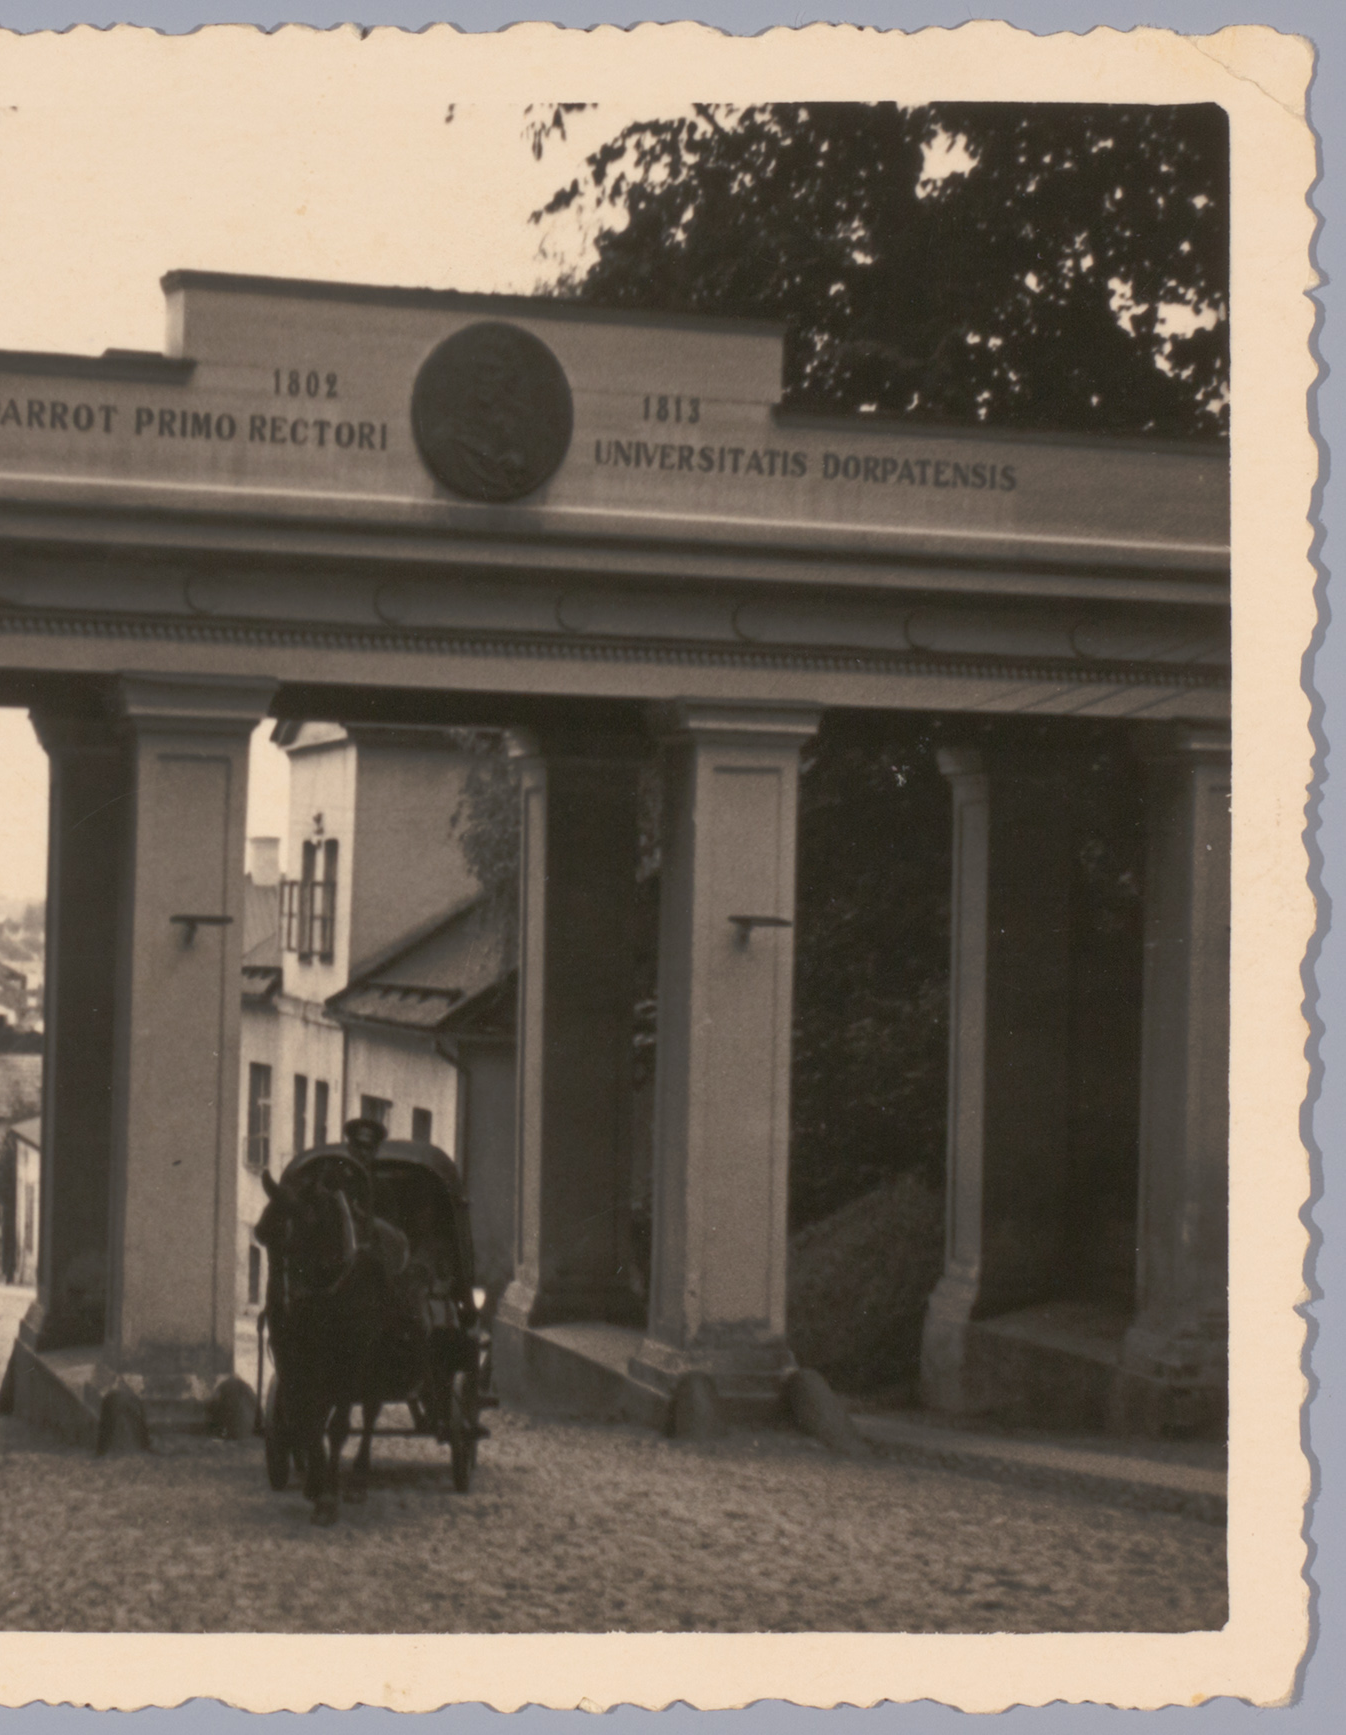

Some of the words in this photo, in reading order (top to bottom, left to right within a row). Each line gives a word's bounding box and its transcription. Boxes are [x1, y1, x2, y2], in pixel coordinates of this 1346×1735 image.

[273, 367, 339, 399] 1802
[134, 406, 237, 443] PRIMO
[248, 413, 389, 452] RECTORI
[642, 395, 701, 424] 1813
[594, 438, 808, 478] UNIVERSITATIS
[822, 451, 1018, 493] DORPATENSIS
